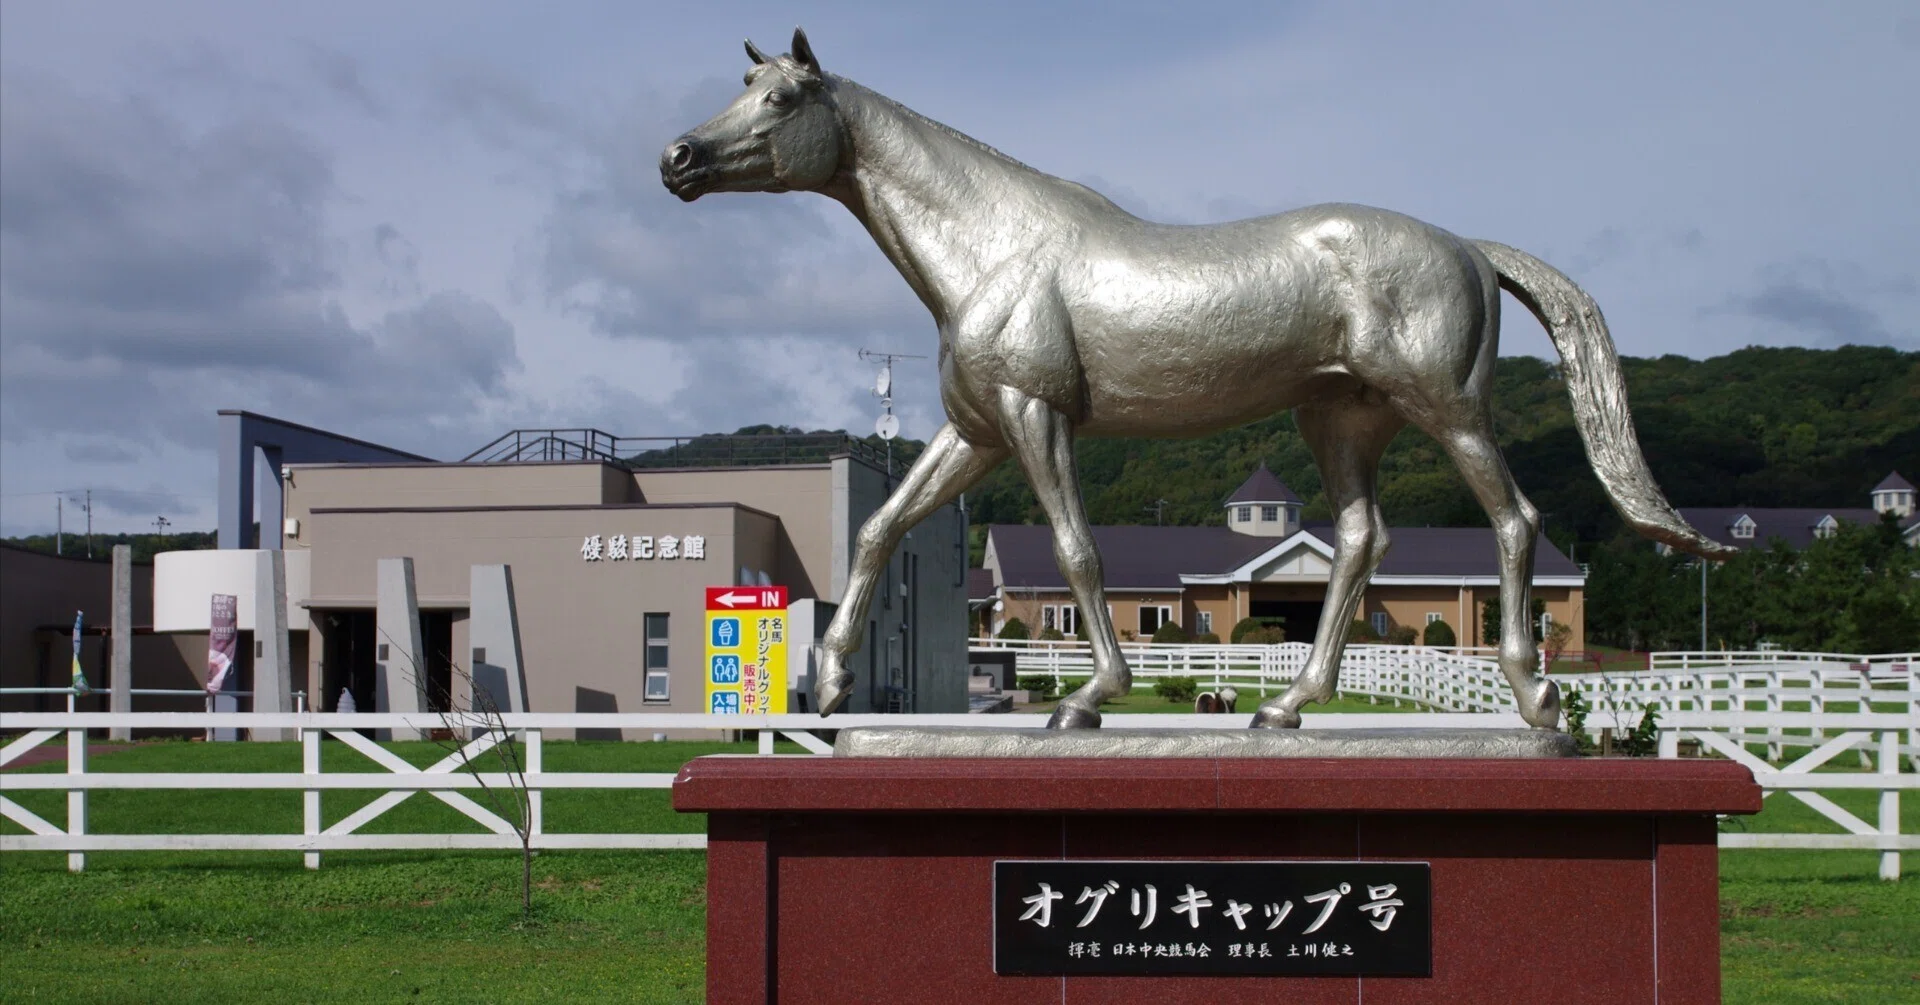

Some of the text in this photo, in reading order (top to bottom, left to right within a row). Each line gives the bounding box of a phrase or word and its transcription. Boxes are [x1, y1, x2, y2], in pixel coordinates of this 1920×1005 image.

[581, 534, 705, 560] 優駿記念館
[762, 591, 779, 607] IN
[771, 618, 782, 643] 名馬
[1019, 880, 1404, 935] オグリキャップ号
[1113, 941, 1212, 958] 日本中央競馬会
[1228, 941, 1273, 958] 理事長
[1286, 941, 1355, 958] 土川健之
